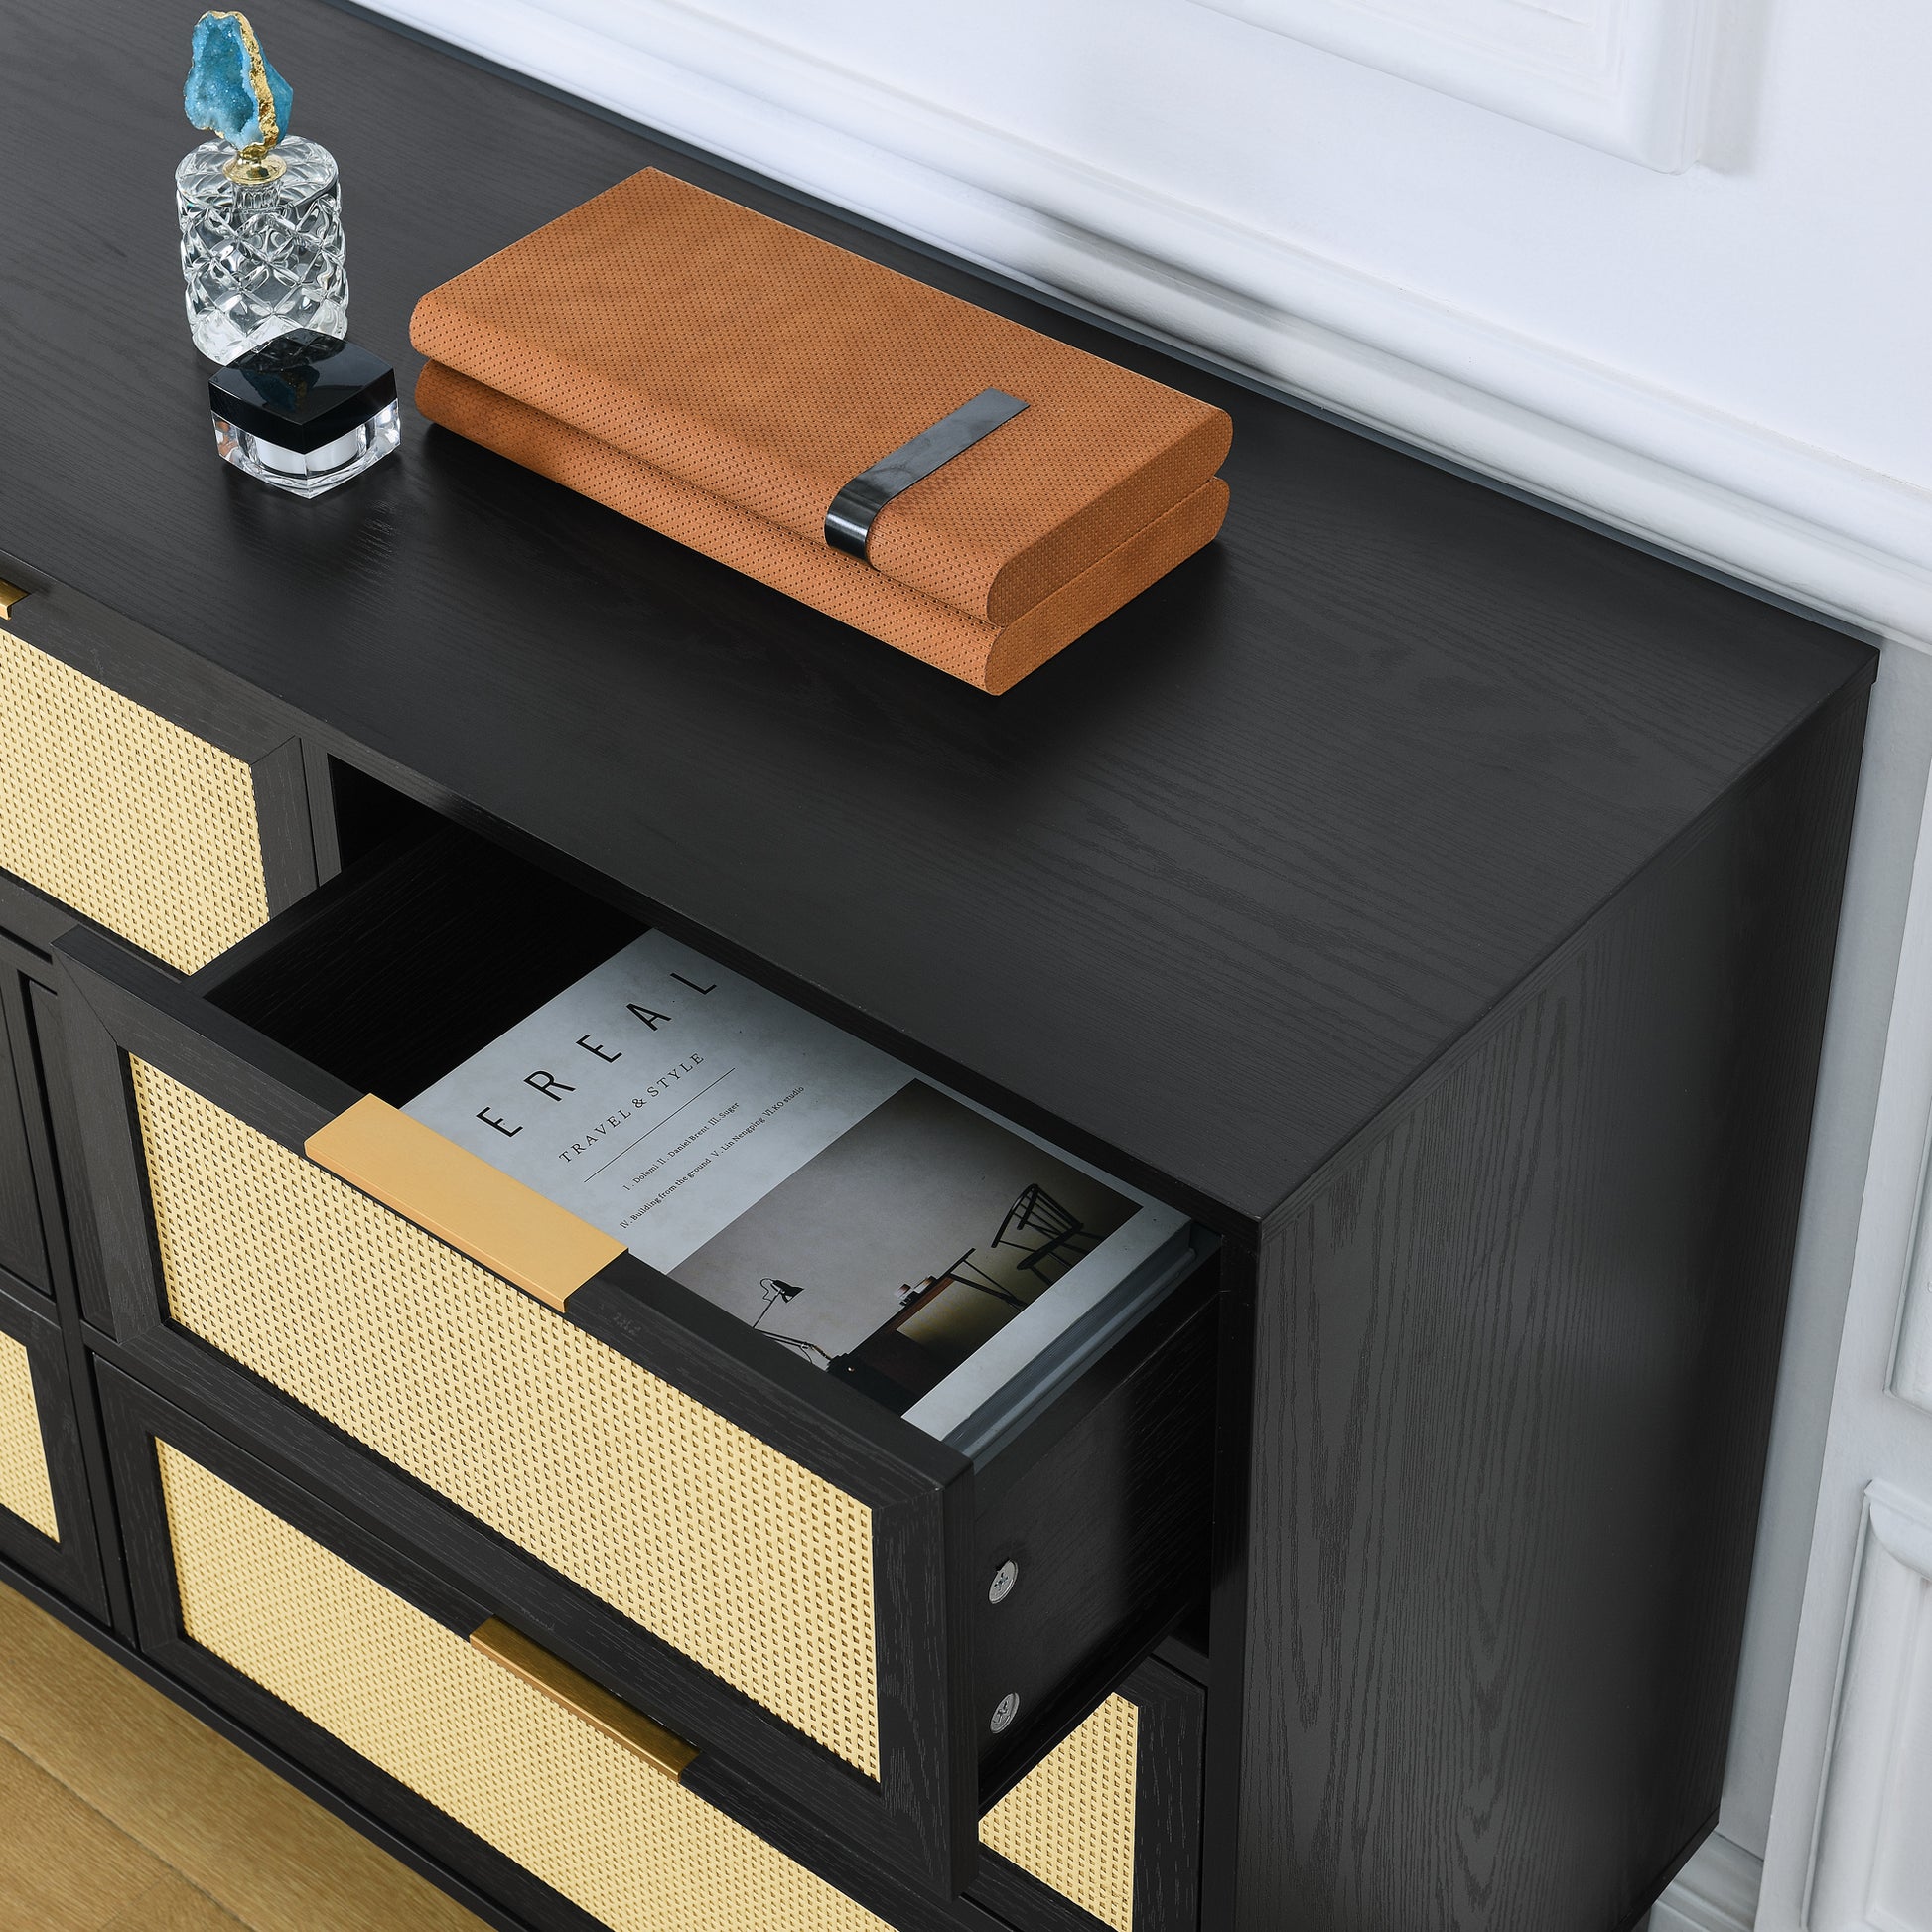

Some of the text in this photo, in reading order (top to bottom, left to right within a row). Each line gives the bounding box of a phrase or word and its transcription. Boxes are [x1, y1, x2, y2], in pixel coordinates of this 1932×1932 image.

[558, 1053, 704, 1164] TRAVEL & STYLE
[630, 1197, 662, 1221] Building
[658, 1185, 677, 1199] from
[675, 1175, 689, 1186] the
[687, 1158, 712, 1178] ground
[720, 1140, 735, 1151] Lin
[783, 1086, 805, 1104] studio
[632, 1164, 659, 1183] Dolomi
[667, 1139, 692, 1158] Daniel
[689, 1125, 709, 1142] Brent
